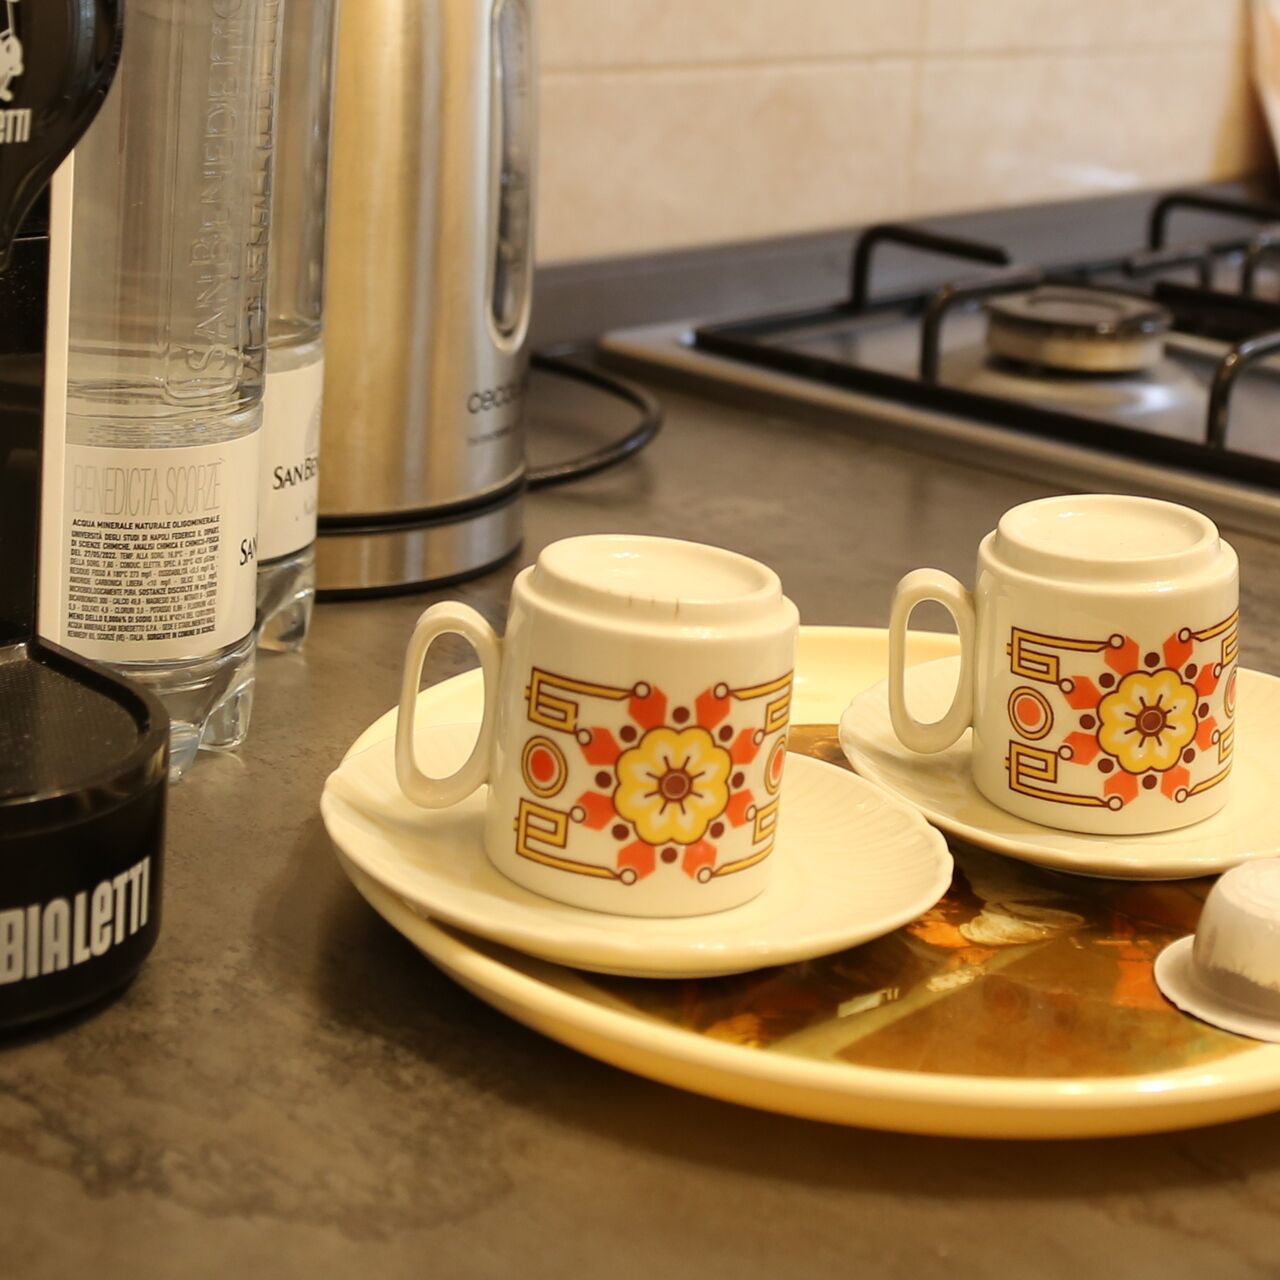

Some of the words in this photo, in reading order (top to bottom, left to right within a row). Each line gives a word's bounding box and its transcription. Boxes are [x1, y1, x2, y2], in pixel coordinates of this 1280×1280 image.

[272, 464, 304, 490] SAN
[72, 464, 160, 516] BENEDICTA
[72, 519, 96, 528] ACQUA
[97, 521, 133, 530] MINERALE
[134, 521, 171, 530] NATURALE
[172, 515, 220, 528] OLIGOMINERALE
[104, 533, 121, 541] DEGLI
[150, 533, 170, 541] NAPOLI
[172, 531, 196, 540] FEDERICO
[71, 539, 77, 547] DI
[78, 540, 101, 549] SCIENZE
[156, 542, 178, 550] CHIMICA
[70, 548, 81, 557] DEL
[136, 552, 149, 560] ALLA
[138, 587, 166, 596] SOSTANZE
[68, 612, 84, 621] MENO
[84, 614, 102, 622] DELLO
[107, 624, 117, 632] SAN
[118, 624, 145, 633] BENEDETTO
